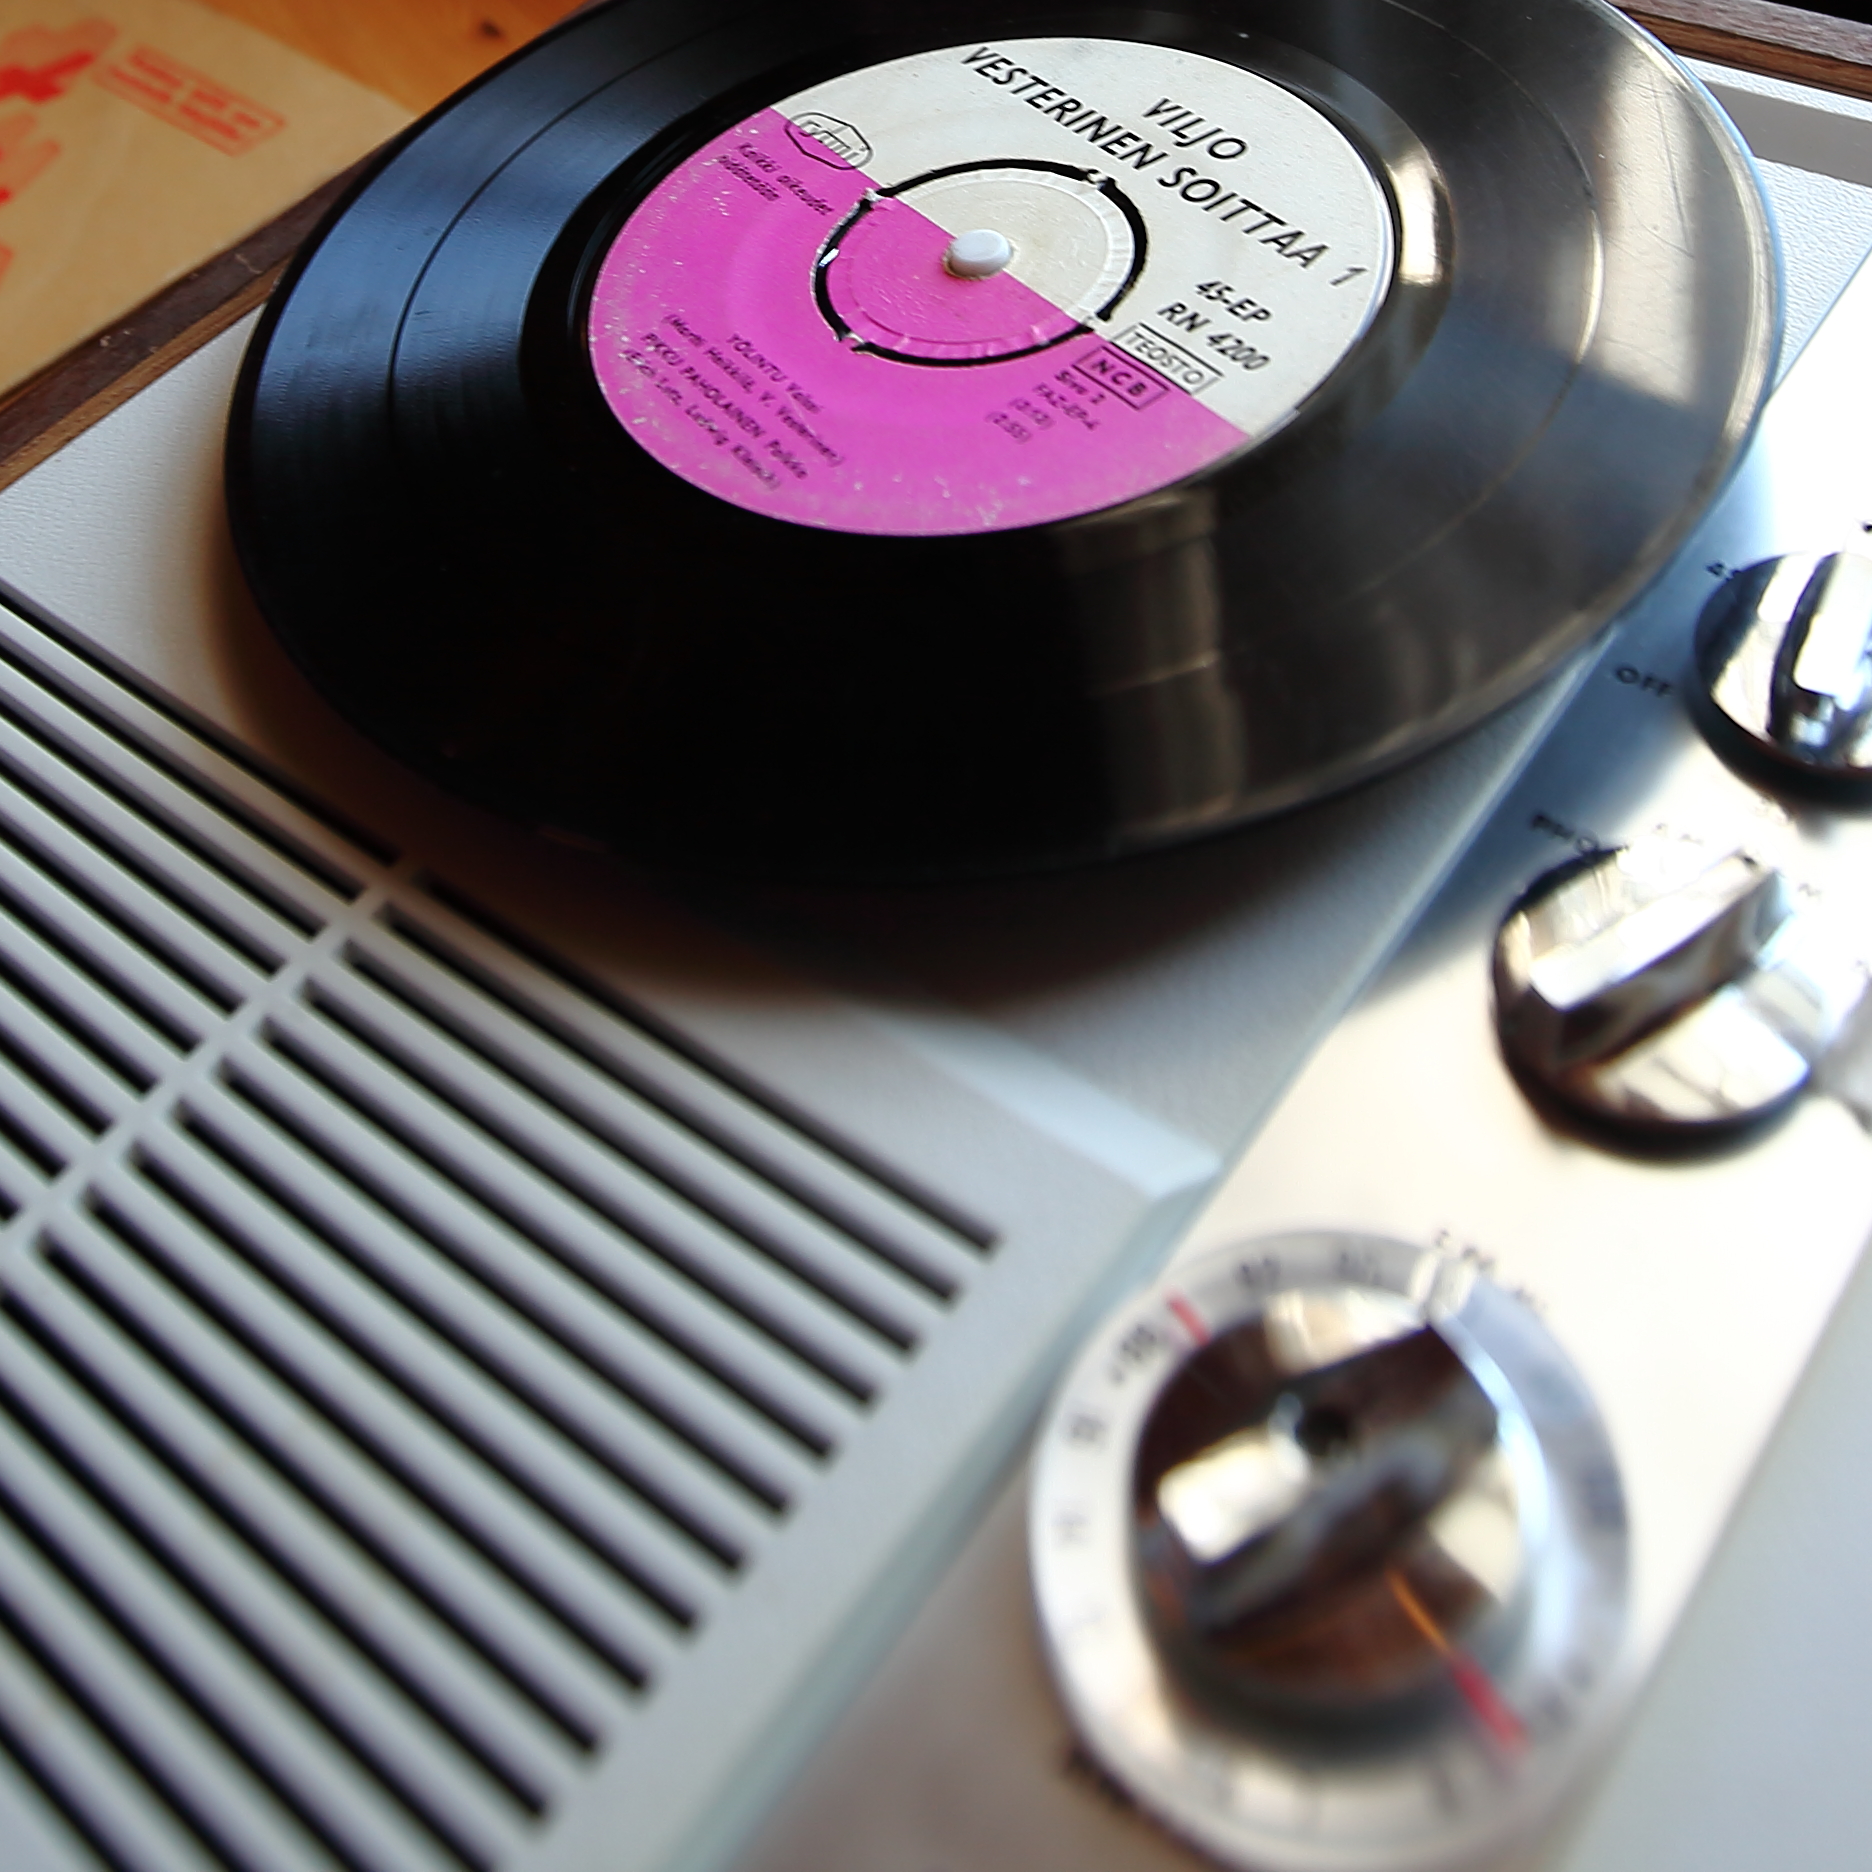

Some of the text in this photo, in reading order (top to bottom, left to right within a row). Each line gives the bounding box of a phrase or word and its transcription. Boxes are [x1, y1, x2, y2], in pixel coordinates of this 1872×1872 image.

[1141, 97, 1249, 161] VILJO
[737, 142, 782, 173] Kaikki
[960, 46, 1369, 288] VESTERINEN SOITTAA 1
[1196, 279, 1273, 324] 45-EP
[1128, 331, 1206, 386] TEOSTO
[1157, 301, 1272, 373] RN 4200
[680, 366, 766, 439] PAHOLAINEN
[1055, 369, 1089, 395] Sivu
[1615, 665, 1674, 699] OFF
